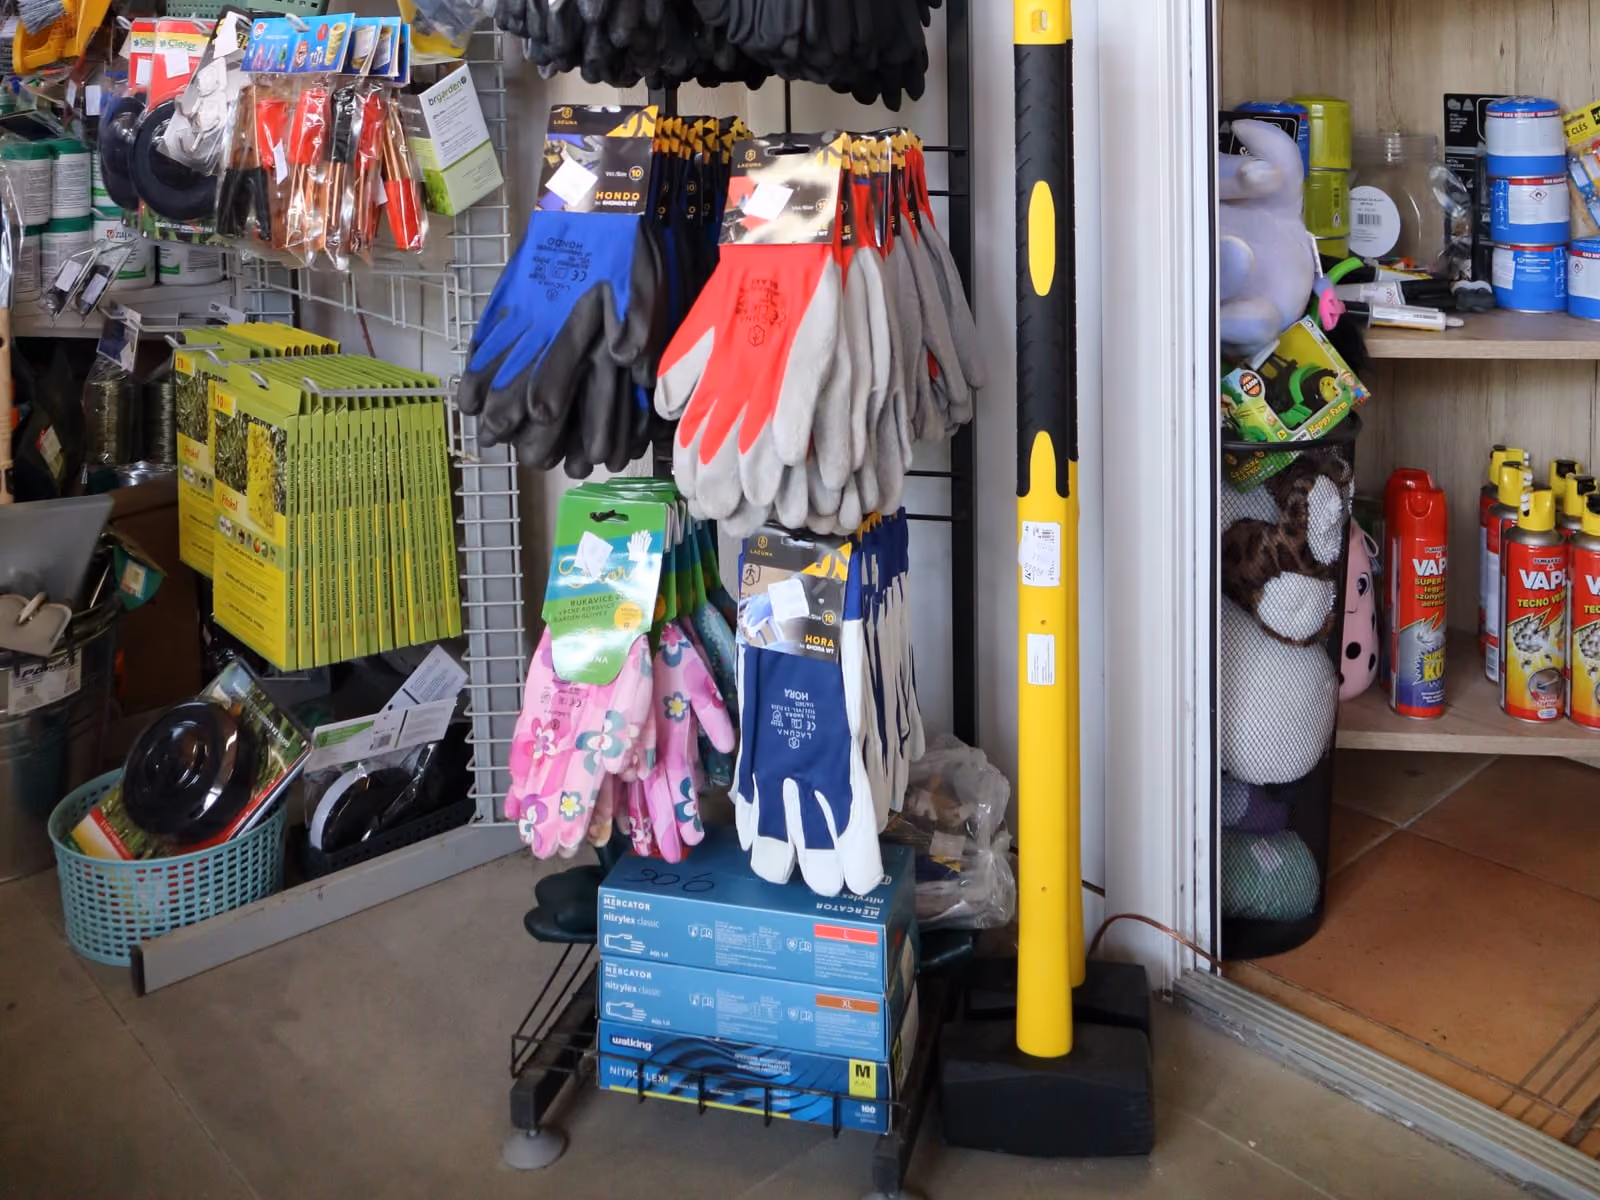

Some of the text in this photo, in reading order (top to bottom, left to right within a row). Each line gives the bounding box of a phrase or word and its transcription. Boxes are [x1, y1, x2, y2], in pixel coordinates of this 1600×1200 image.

[427, 81, 463, 106] brgarden
[1571, 122, 1589, 136] CLÉS
[595, 191, 641, 201] HONDO
[546, 236, 584, 250] HONDO
[1307, 416, 1331, 435] Happy
[1329, 401, 1348, 417] Farm
[749, 548, 773, 557] LACUNA
[1584, 574, 1600, 596] V
[570, 595, 614, 607] RUKAVICE
[1516, 598, 1550, 608] TECNO
[805, 634, 834, 648] HORA
[784, 688, 809, 701] HORA
[806, 720, 817, 731] CE
[777, 727, 812, 740] LACUNA
[603, 896, 651, 912] MERCATOR
[816, 902, 880, 917] MERCATOR
[603, 912, 661, 929] nitrylex classic
[605, 965, 652, 979] MERCATOR
[605, 980, 662, 997] nitrylex classic
[841, 999, 853, 1009] XL
[855, 1064, 871, 1079] M
[861, 1104, 876, 1114] 100
